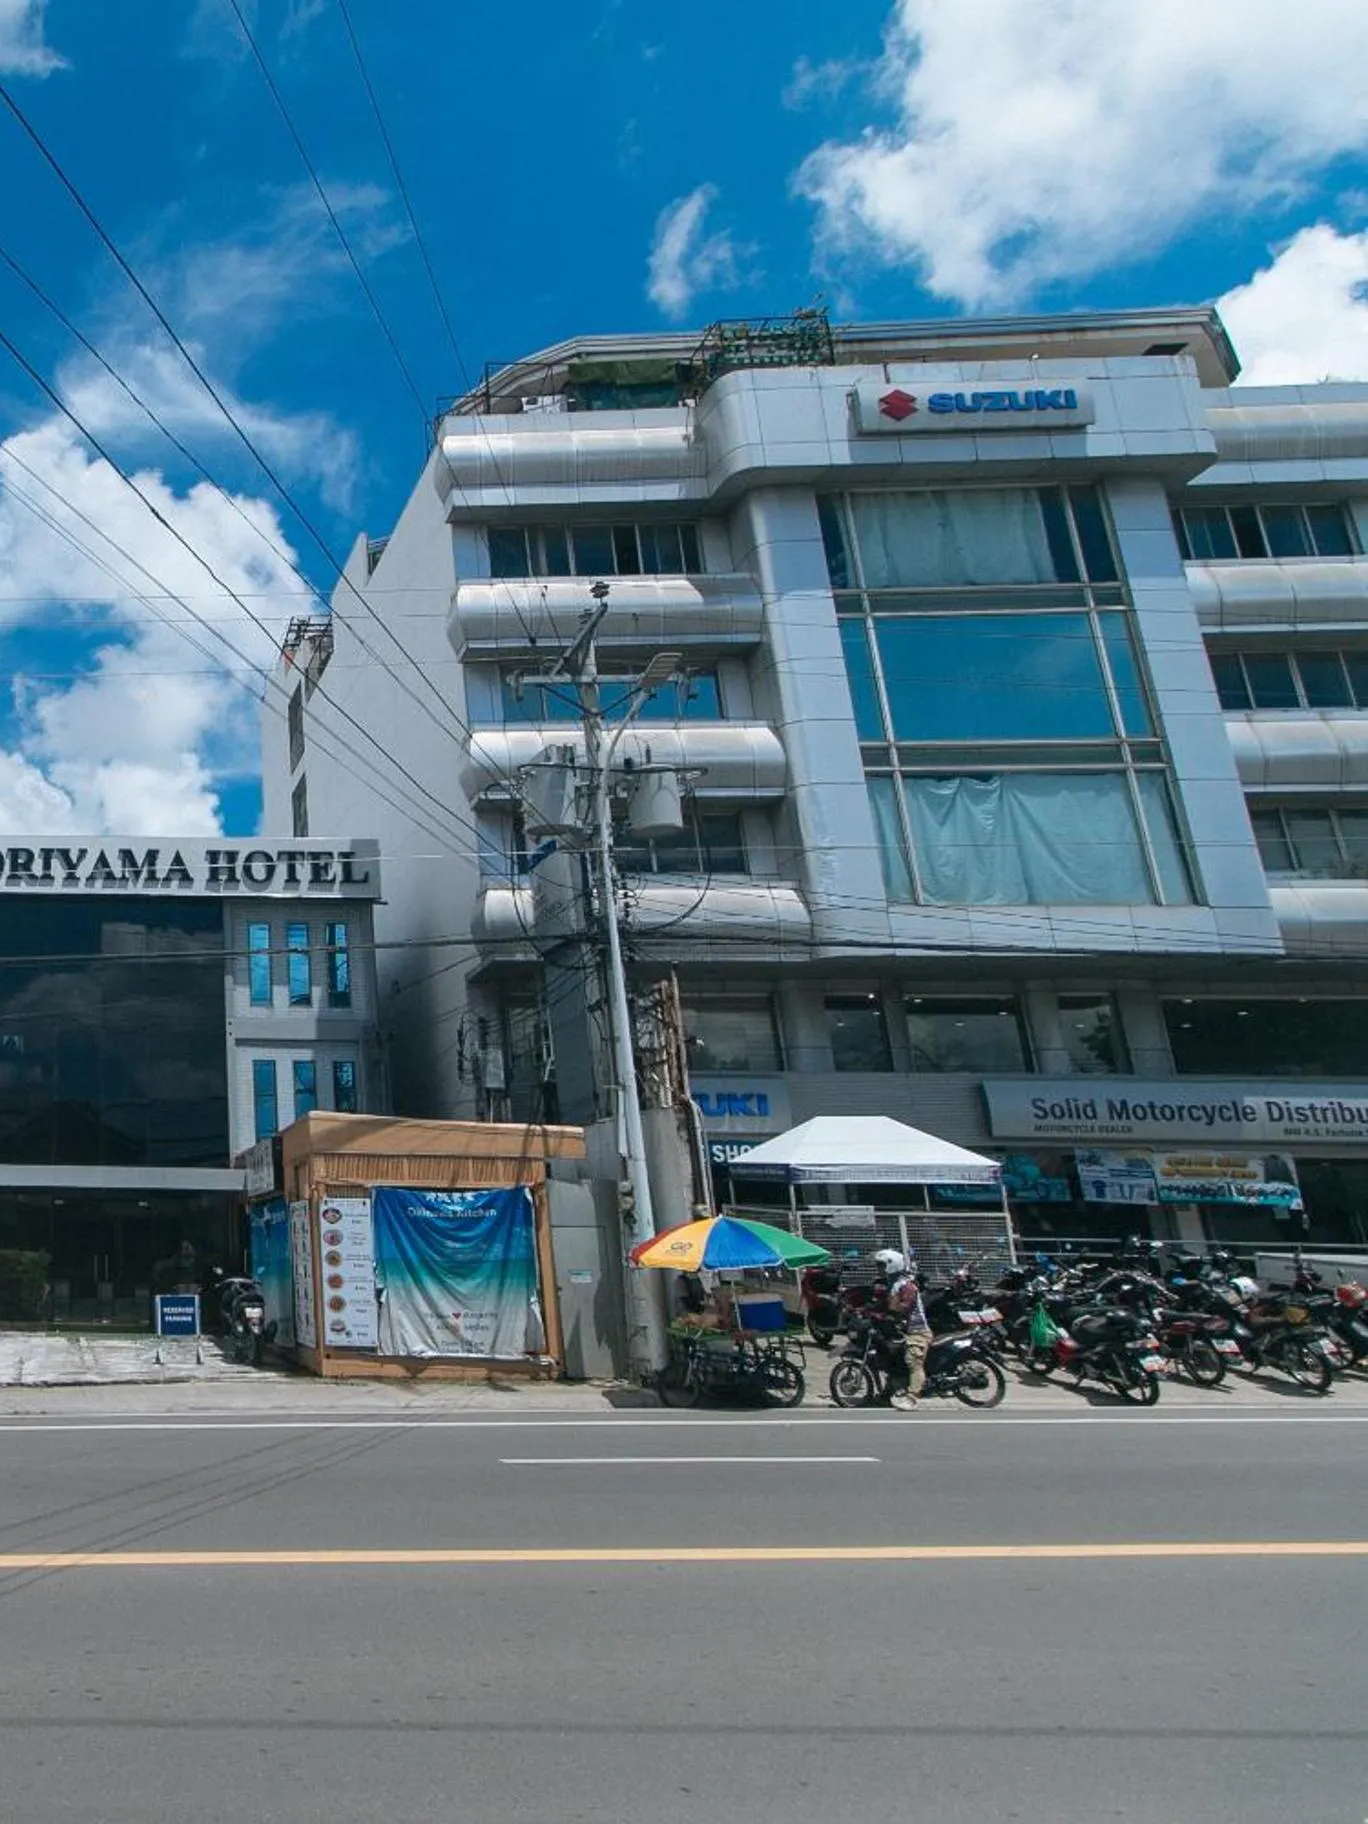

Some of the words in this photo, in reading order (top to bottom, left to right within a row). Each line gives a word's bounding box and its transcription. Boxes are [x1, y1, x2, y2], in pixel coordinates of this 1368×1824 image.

[928, 389, 1078, 414] SUZUKI
[205, 849, 369, 890] HOTEL
[1032, 1098, 1098, 1121] Solid
[1107, 1099, 1257, 1127] Motorcycle
[1034, 1124, 1096, 1134] MOTORCYCLE
[1098, 1124, 1133, 1134] DEALER
